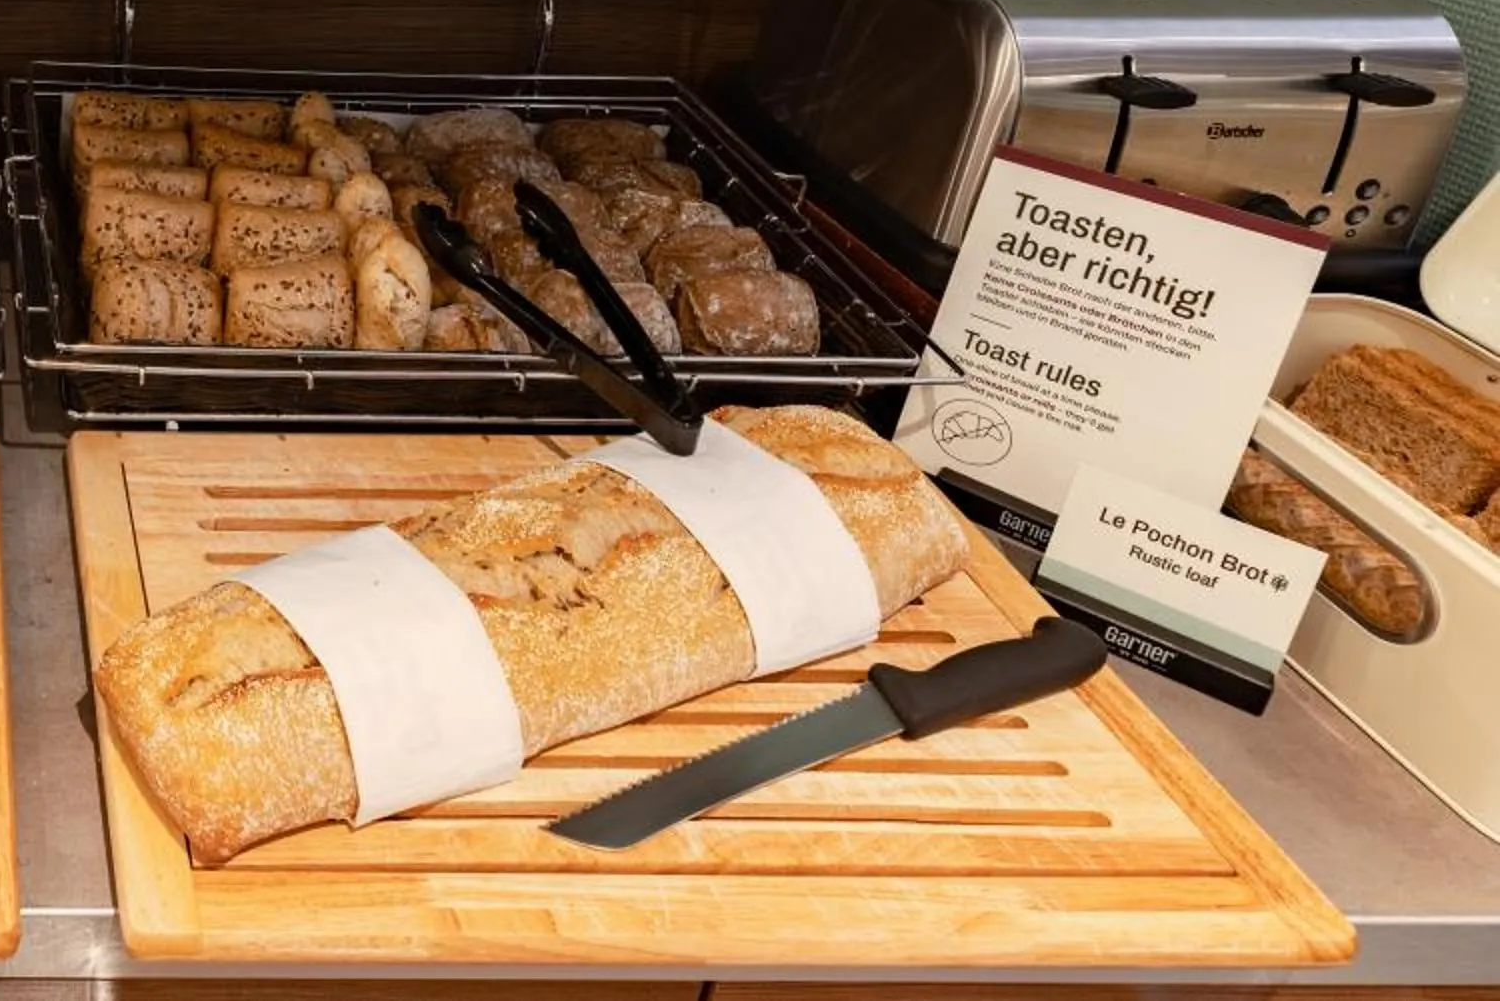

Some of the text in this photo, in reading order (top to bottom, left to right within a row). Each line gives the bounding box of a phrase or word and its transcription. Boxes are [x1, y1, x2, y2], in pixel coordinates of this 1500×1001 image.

[1014, 190, 1154, 263] Toasten,
[996, 231, 1215, 319] aber richtig!
[964, 328, 1030, 371] Toast
[1035, 360, 1101, 397] rules
[999, 510, 1051, 543] Garne
[1099, 506, 1268, 583] Le Pochon Brot
[1128, 544, 1219, 588] Rustic loaf
[1104, 625, 1175, 664] Garner
